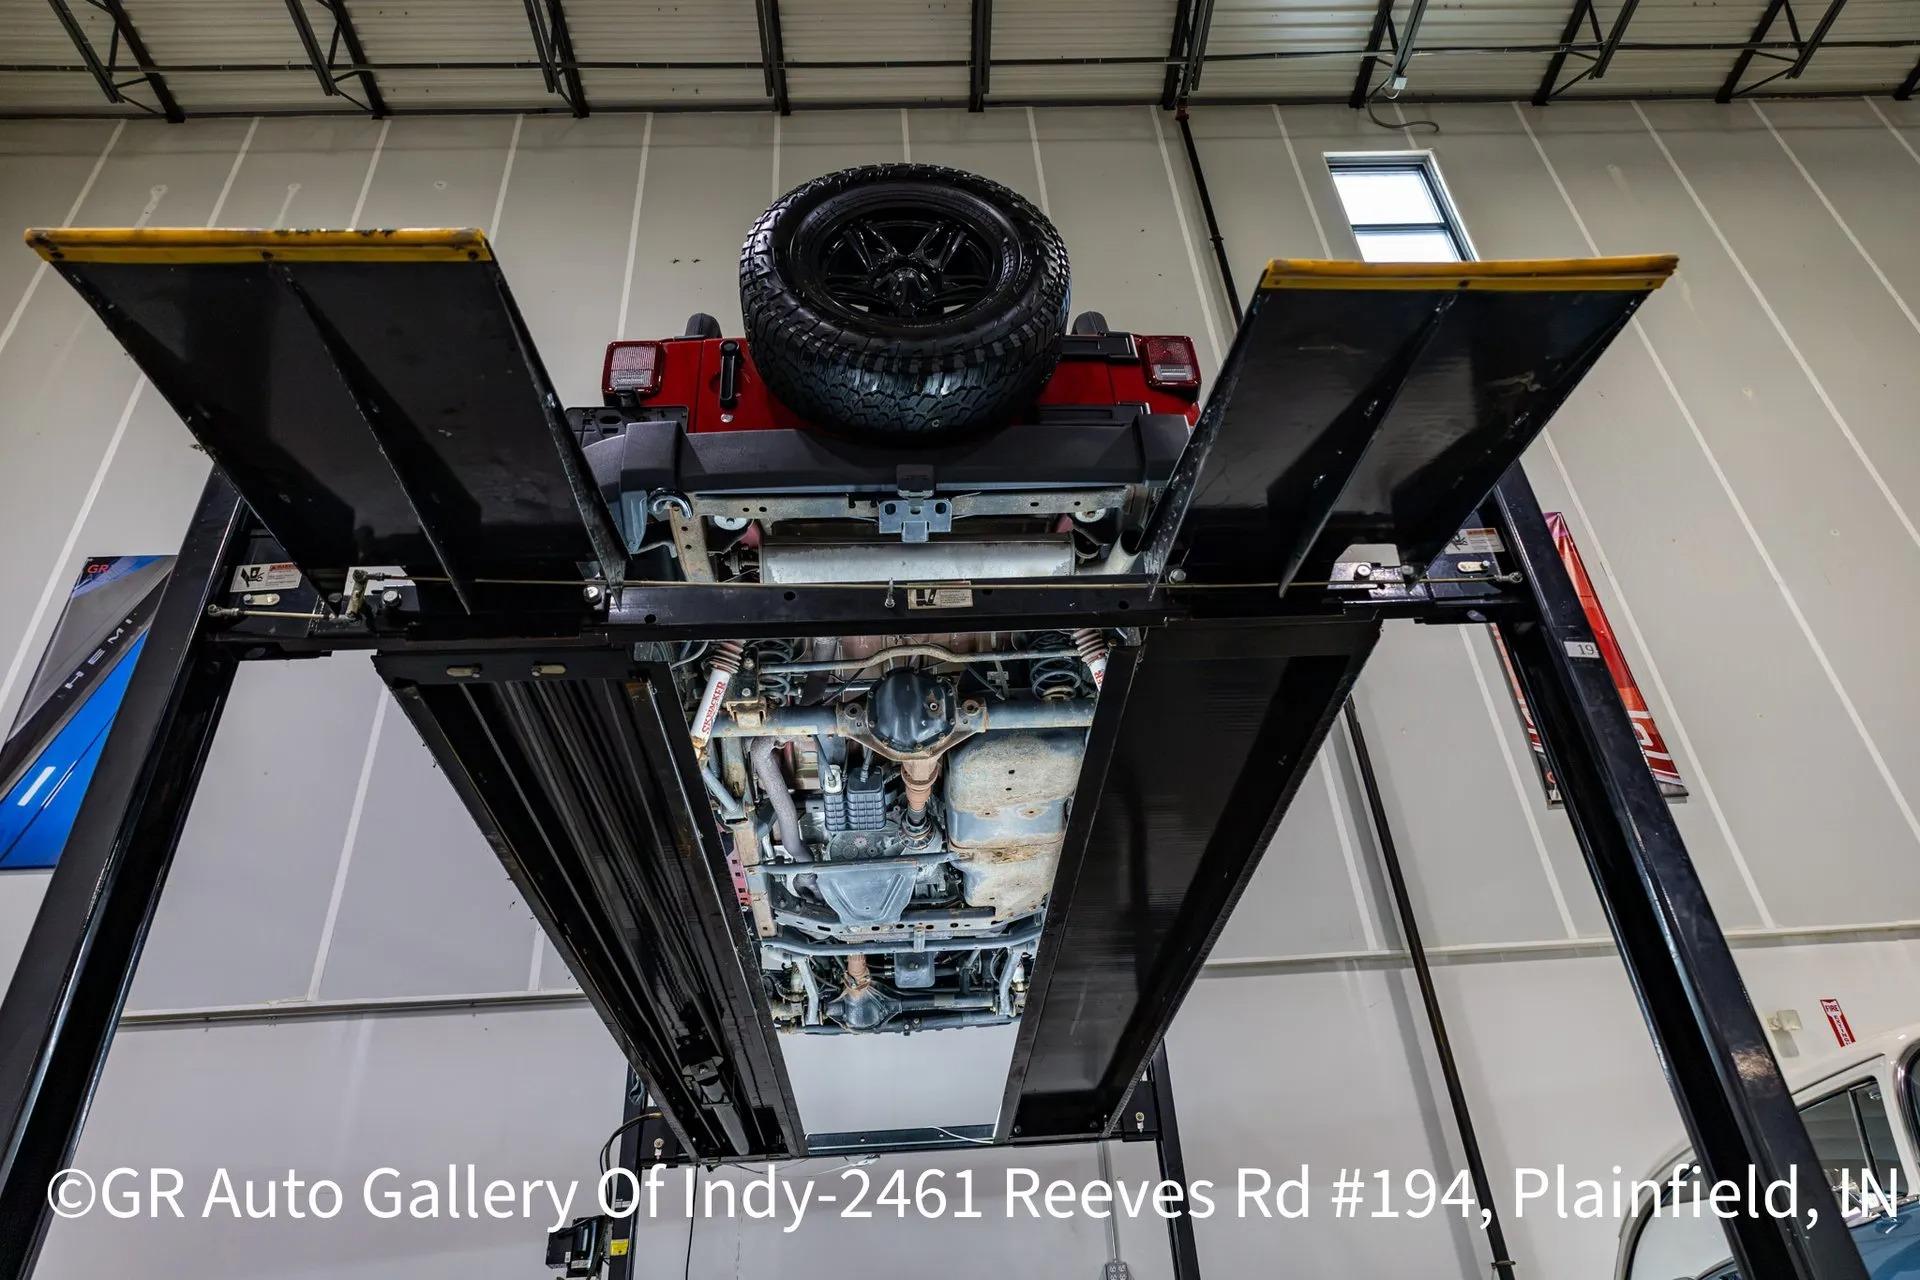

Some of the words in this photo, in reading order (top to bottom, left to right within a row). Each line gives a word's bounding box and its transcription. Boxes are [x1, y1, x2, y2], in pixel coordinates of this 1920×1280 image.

[87, 564, 109, 574] GR
[65, 617, 133, 689] HEMI
[702, 681, 726, 735] SKYJACKER
